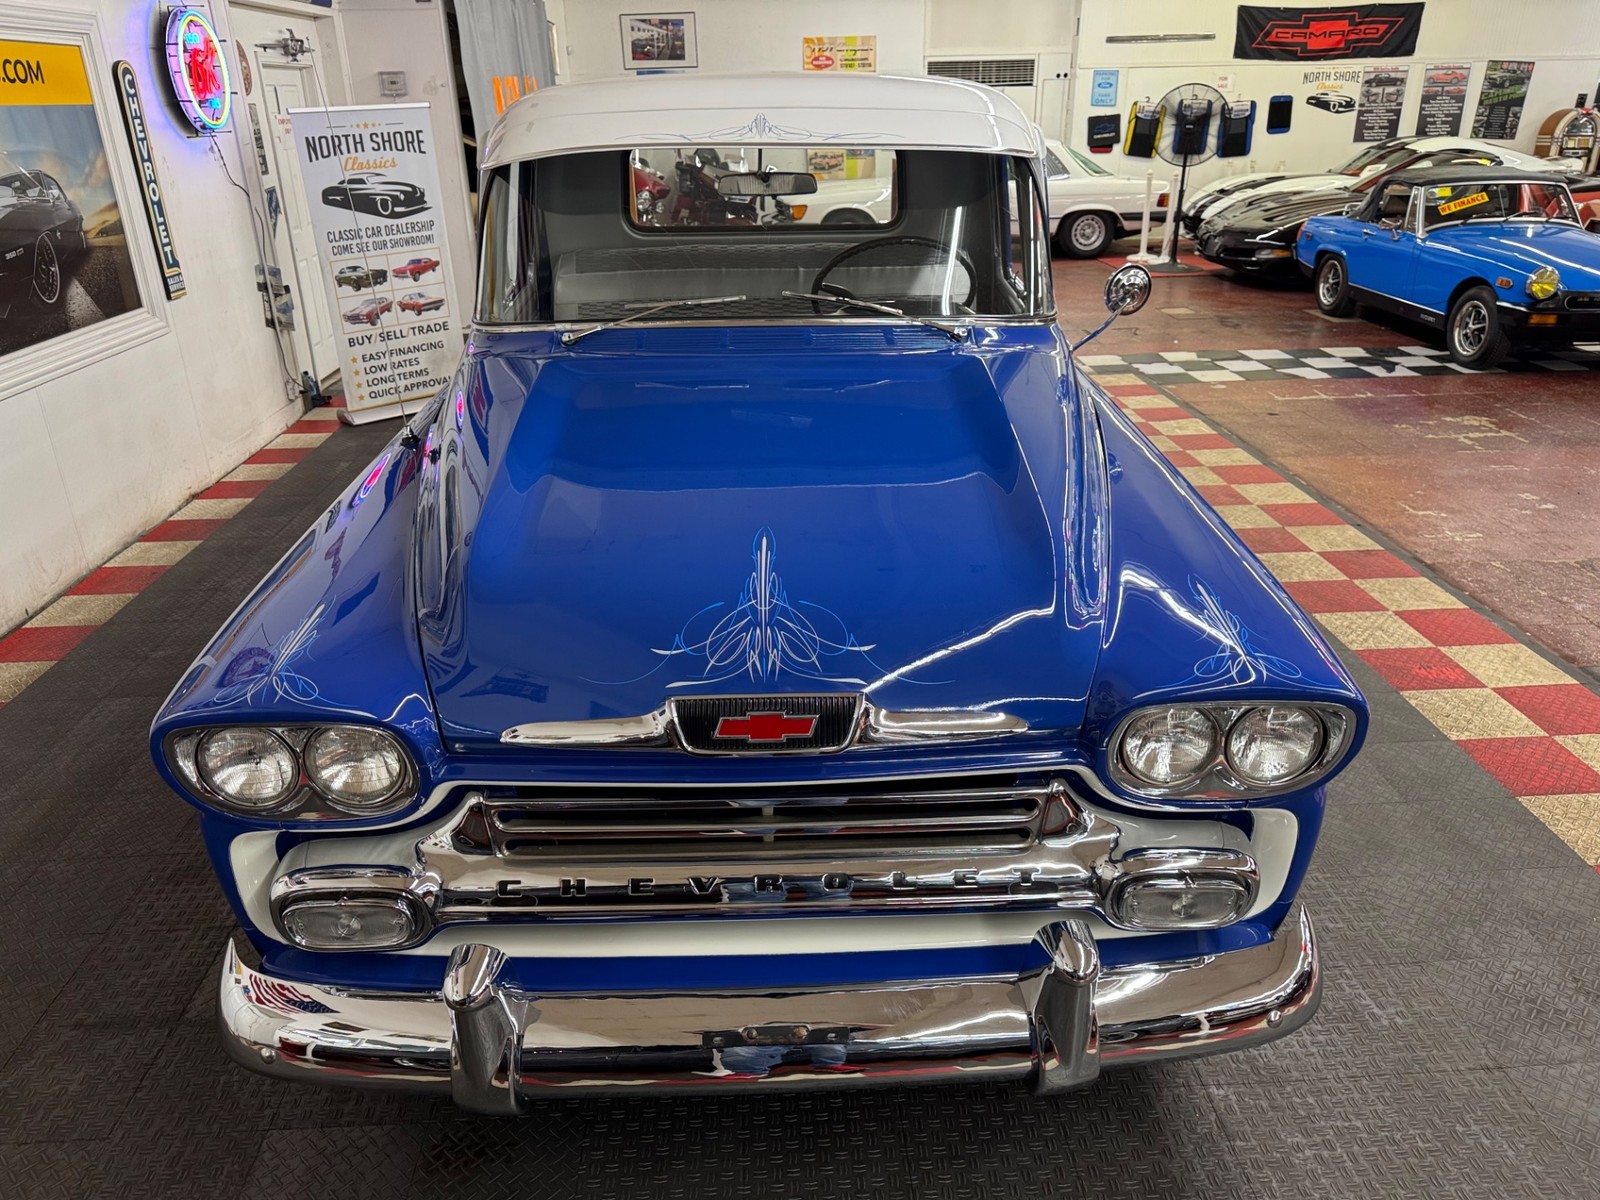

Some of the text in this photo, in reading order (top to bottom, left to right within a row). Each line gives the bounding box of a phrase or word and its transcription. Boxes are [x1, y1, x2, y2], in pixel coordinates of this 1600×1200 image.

[1274, 26, 1381, 40] CAMARO
[2, 58, 46, 85] .COM
[1302, 70, 1362, 85] NORTH SHORE
[305, 129, 427, 163] NORTH SHORE
[124, 73, 174, 264] CHEVROLET
[343, 156, 398, 172] Classics
[1440, 193, 1486, 214] WE FINANCE
[327, 219, 435, 243] CLASSIC CAR DEALERSHIP
[331, 234, 435, 256] COME SEE OUR SHOWROOM!
[361, 340, 445, 363] EASY FINANCING
[363, 357, 420, 375] LOW RATES
[366, 368, 430, 388] LONG TERMS
[368, 386, 401, 399] QUICK
[496, 866, 1042, 898] CHEVROLET
